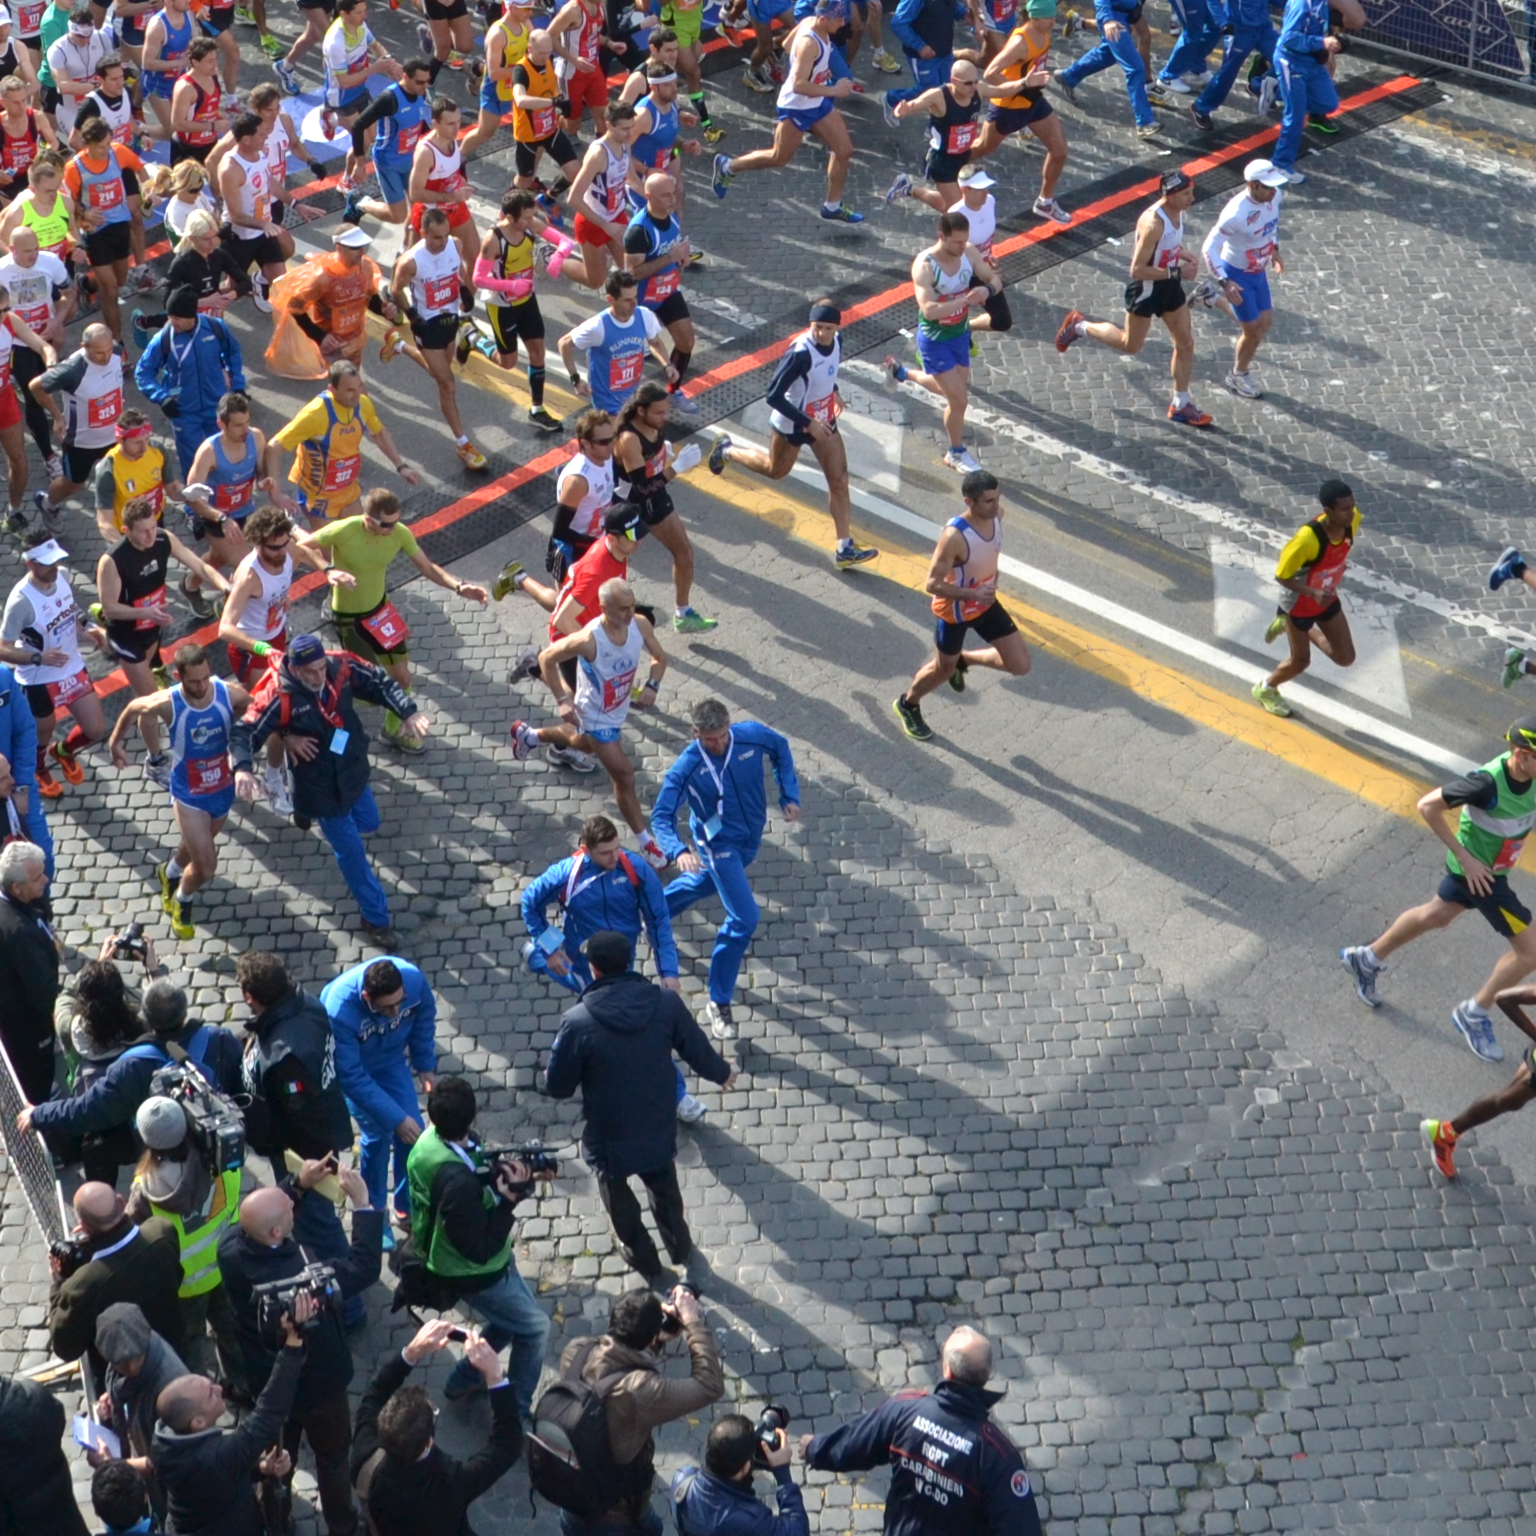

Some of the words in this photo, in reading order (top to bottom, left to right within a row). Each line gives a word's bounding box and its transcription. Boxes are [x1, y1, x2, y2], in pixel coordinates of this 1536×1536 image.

[99, 189, 115, 202] 214
[434, 287, 452, 302] 306
[622, 368, 635, 380] 171
[379, 621, 393, 636] 62
[201, 768, 222, 783] 150
[913, 1414, 973, 1457] ASSOCIAZIONE
[921, 1441, 949, 1467] RGPT
[900, 1457, 964, 1498] CARABINIERI
